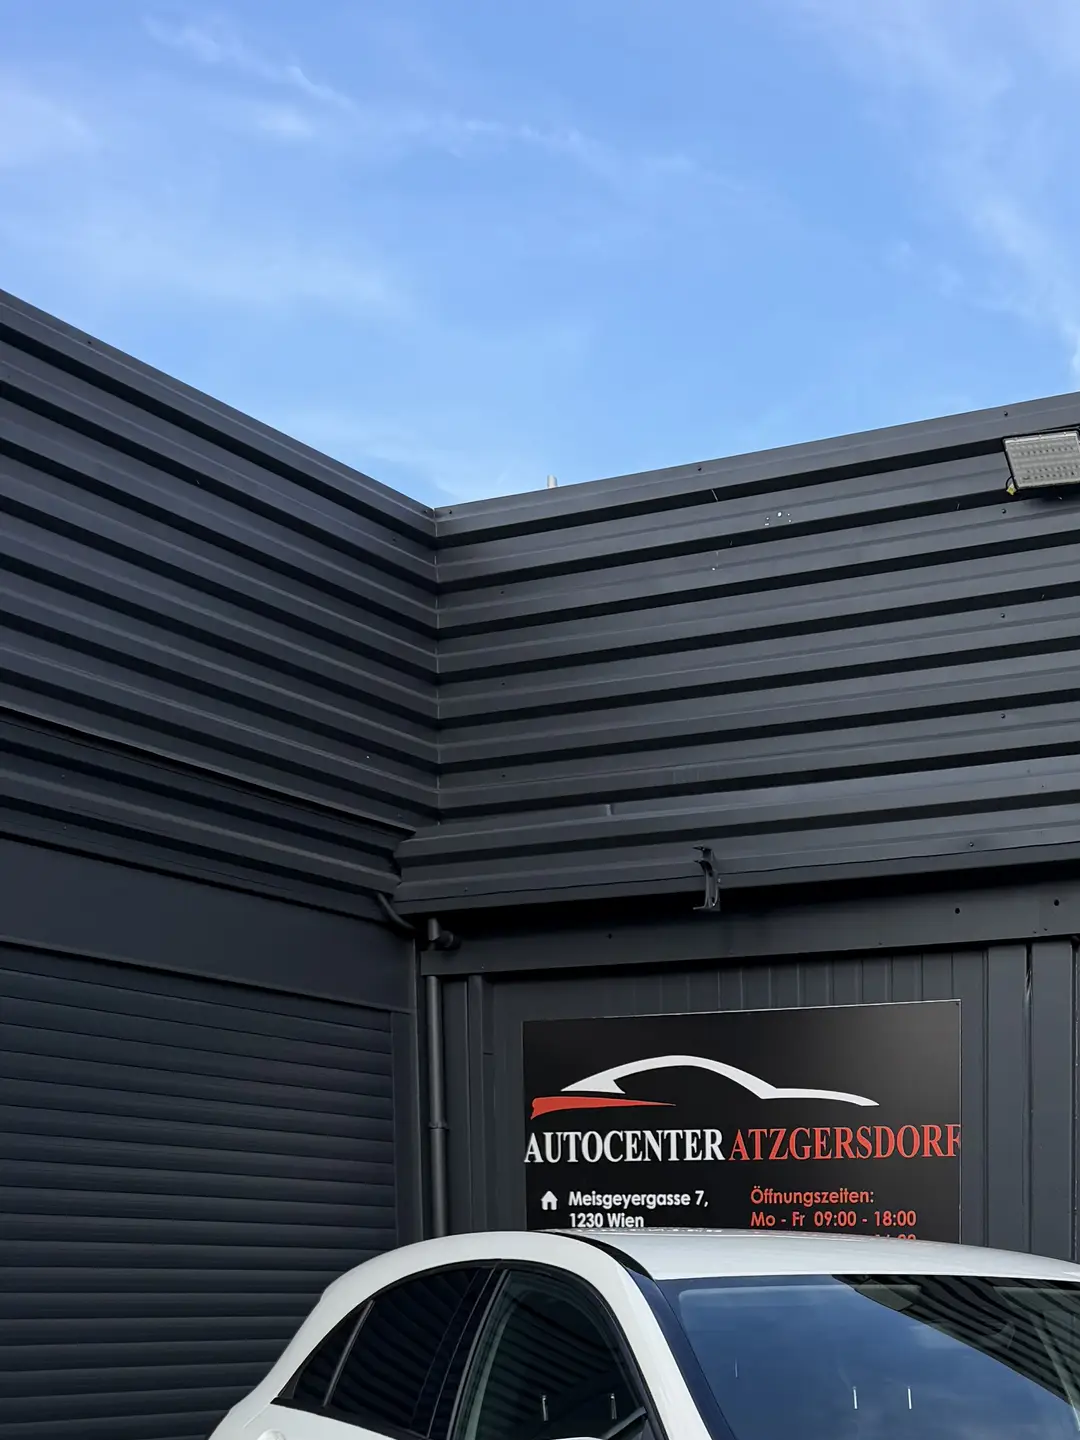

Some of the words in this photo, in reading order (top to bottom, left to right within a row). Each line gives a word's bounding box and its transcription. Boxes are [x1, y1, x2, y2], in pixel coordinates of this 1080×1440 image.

[523, 1128, 726, 1164] AUTOCENTER
[728, 1123, 961, 1161] ATZGERSDORF
[568, 1190, 691, 1210] Meisgeyergasse
[694, 1190, 709, 1208] 7,
[750, 1185, 874, 1207] Öffnungszeiten:
[569, 1212, 604, 1228] 1230
[607, 1212, 644, 1228] Wien
[750, 1211, 776, 1227] Mo
[792, 1211, 806, 1227] Fr
[814, 1210, 857, 1227] 09:00
[874, 1210, 917, 1227] 18:00
